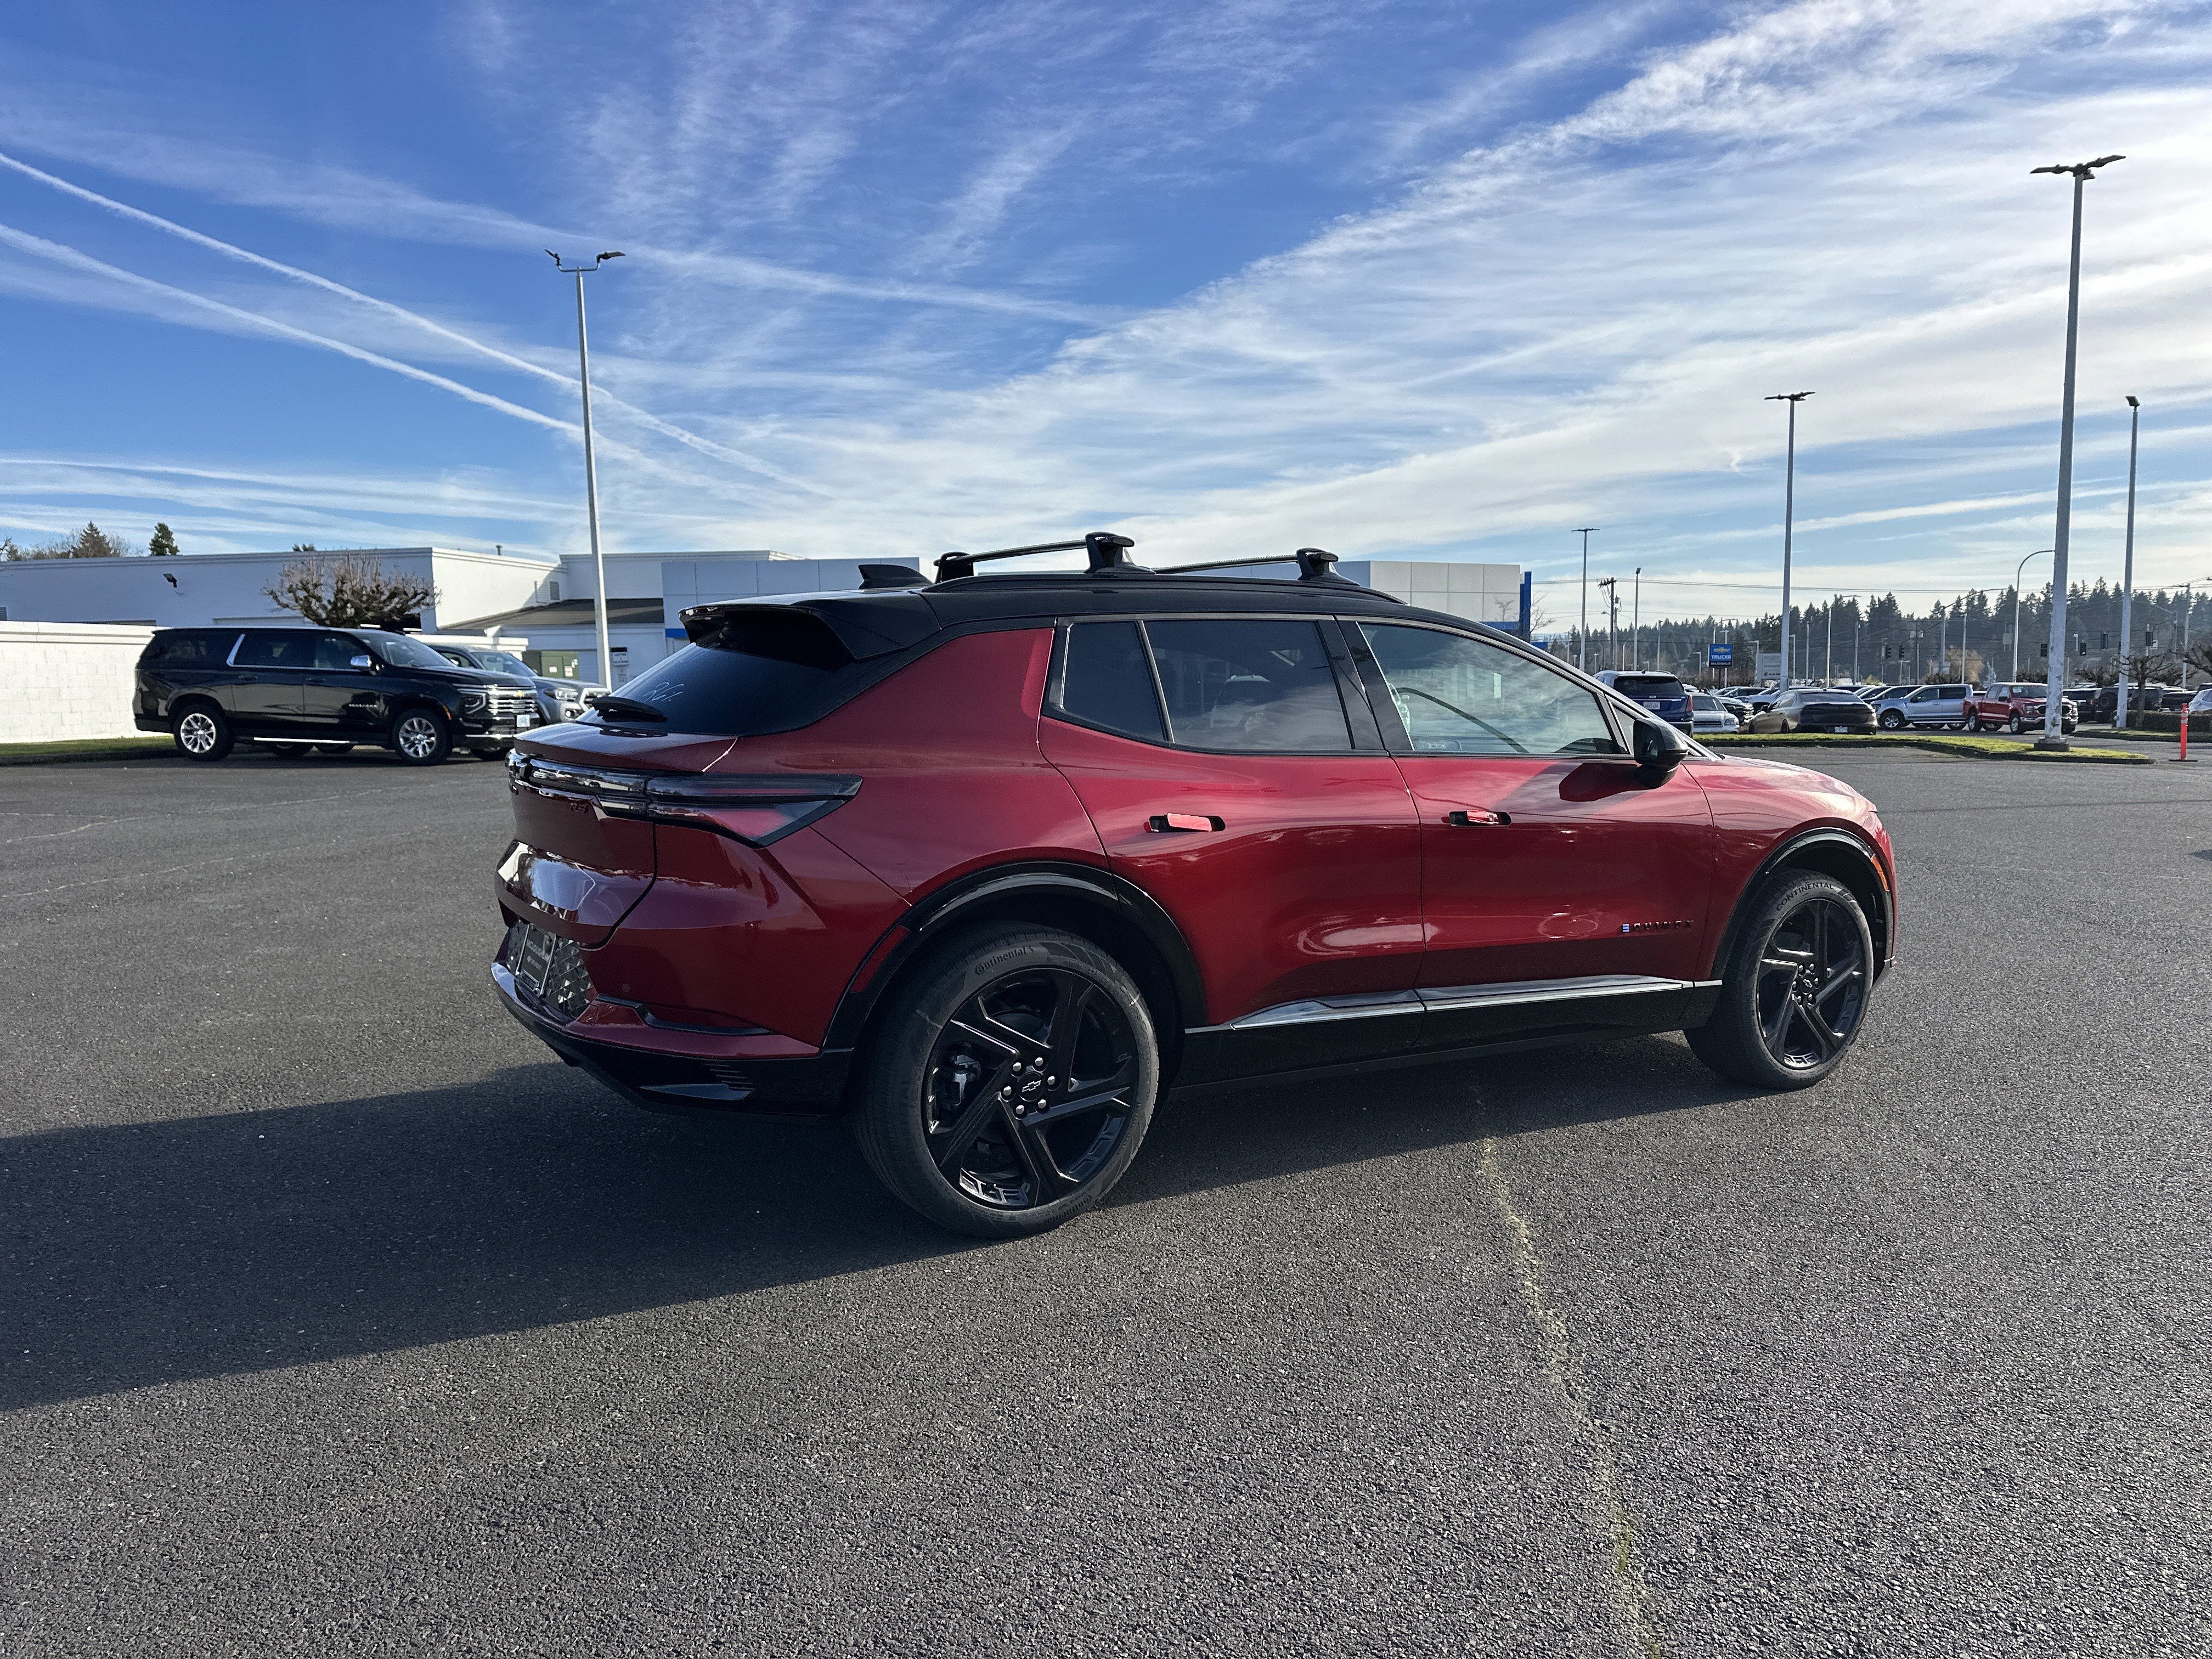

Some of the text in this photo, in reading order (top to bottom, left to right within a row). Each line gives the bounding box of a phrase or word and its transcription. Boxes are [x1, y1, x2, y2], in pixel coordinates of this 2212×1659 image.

[1776, 882, 1834, 911] CONTINENTAL
[974, 946, 1028, 976] Continental
[1044, 1194, 1092, 1224] Continental
